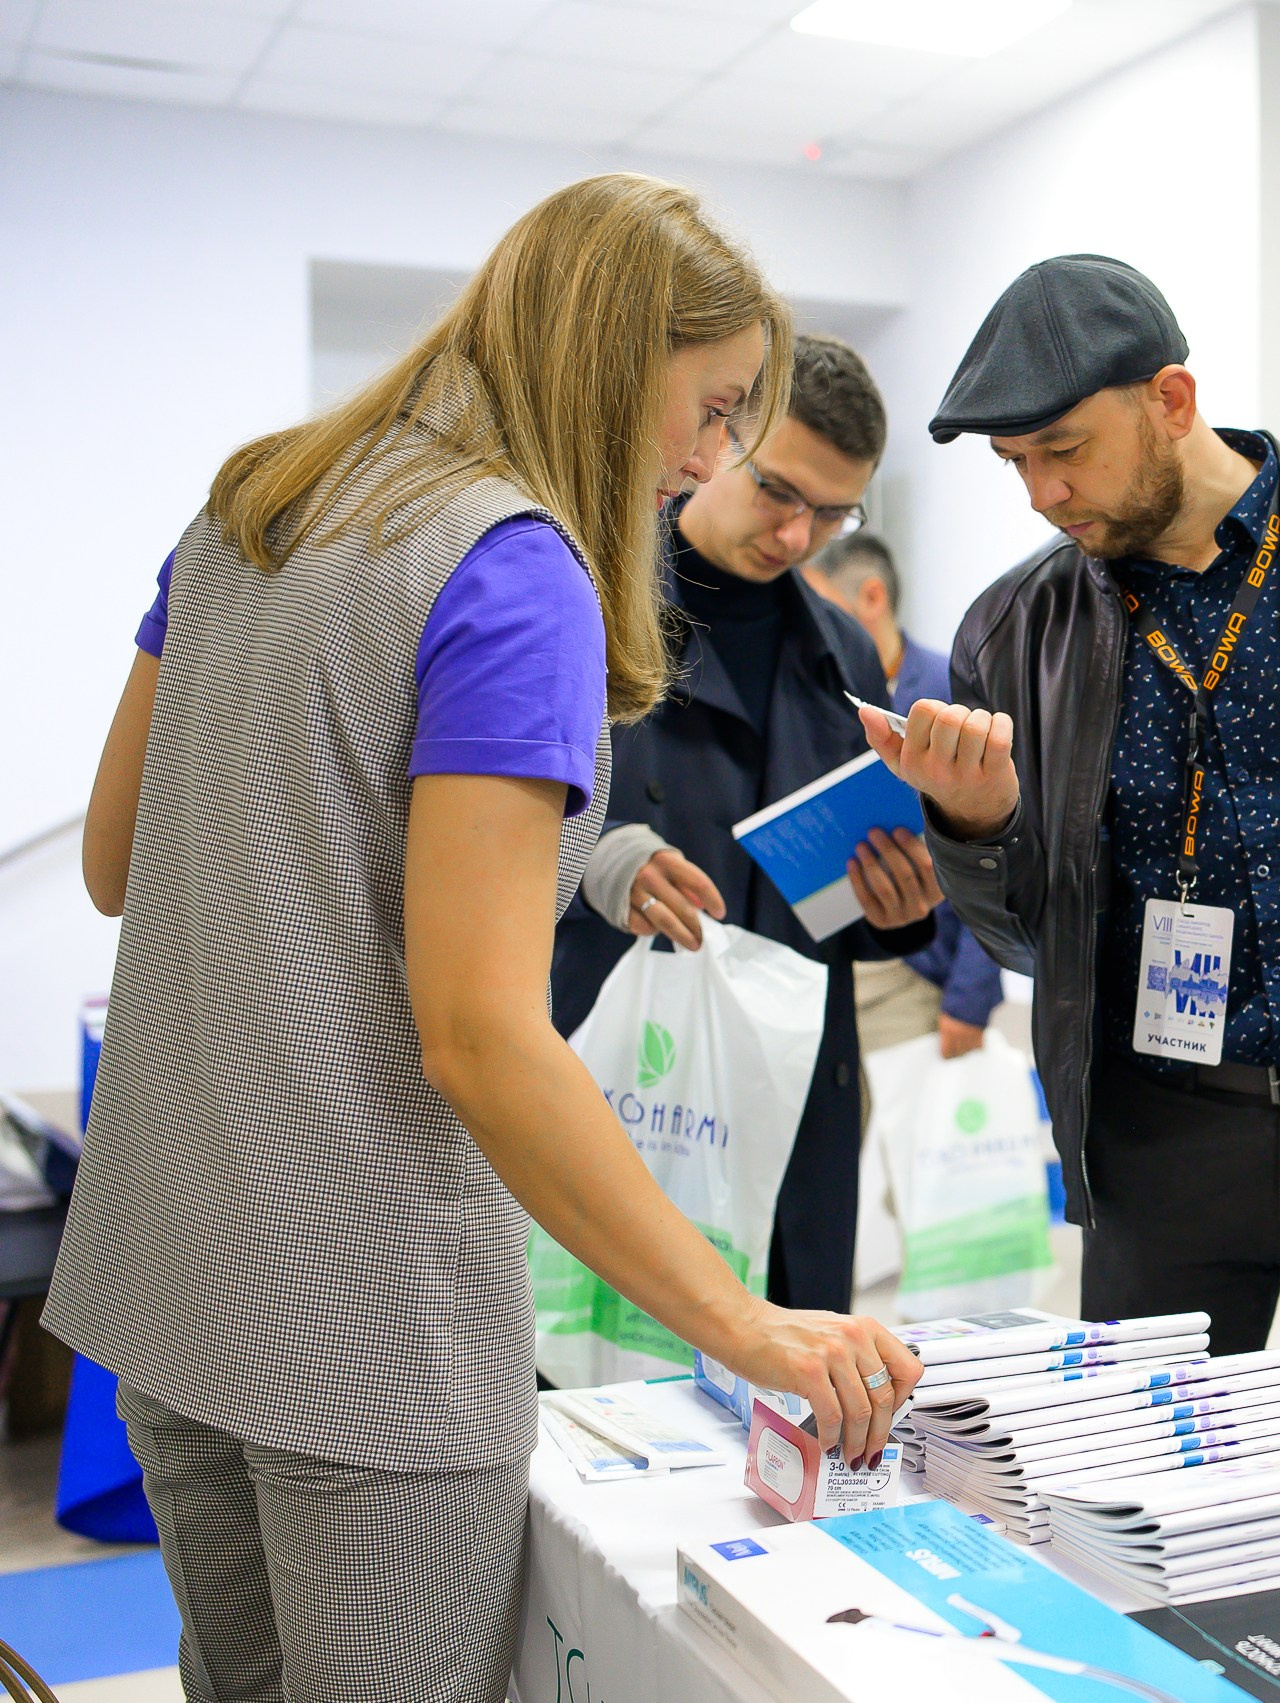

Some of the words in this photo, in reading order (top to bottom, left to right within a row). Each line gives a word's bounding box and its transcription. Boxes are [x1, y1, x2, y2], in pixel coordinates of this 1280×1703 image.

[1146, 630, 1199, 691] BOWA
[1203, 612, 1247, 691] BOWA
[1184, 770, 1204, 856] BOWA
[1147, 1033, 1207, 1053] УЧАСТНИК
[829, 1462, 845, 1471] 3-0
